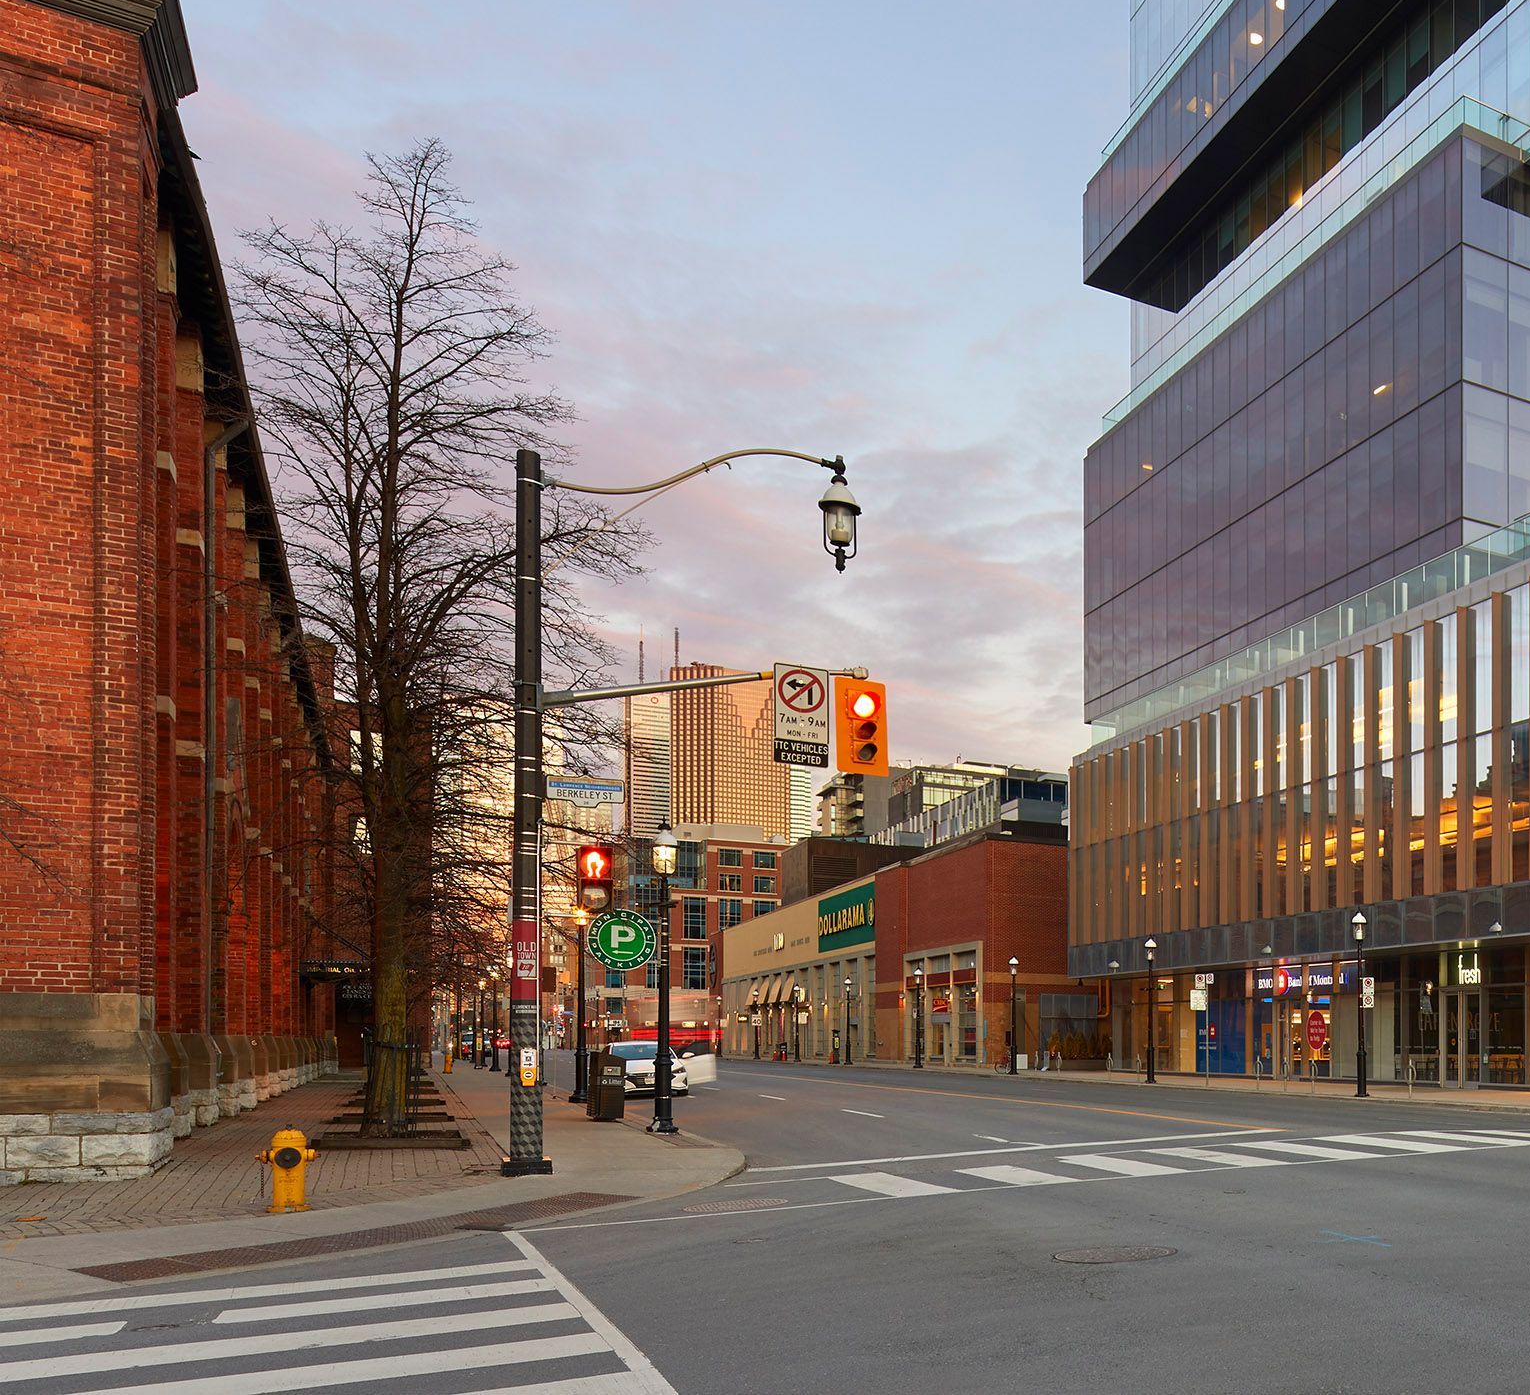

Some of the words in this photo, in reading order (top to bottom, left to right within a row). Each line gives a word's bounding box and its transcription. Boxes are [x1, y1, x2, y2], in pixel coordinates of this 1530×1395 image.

[779, 713, 797, 724] 7AM
[808, 717, 826, 728] 9AM
[775, 740, 789, 750] TTC
[791, 742, 828, 755] VEHICLES
[781, 753, 821, 765] EXCEPTED
[556, 789, 600, 800] BERKELEY
[602, 792, 614, 801] ST.
[592, 912, 652, 940] MUNCIPAL
[819, 903, 865, 937] DOLLARAMA
[610, 925, 636, 948] P
[517, 941, 536, 952] OLD
[517, 952, 536, 960] TOWN
[592, 942, 651, 968] PARKING
[1458, 953, 1481, 984] fresh
[1258, 978, 1273, 989] BMO
[1313, 973, 1344, 986] Montral
